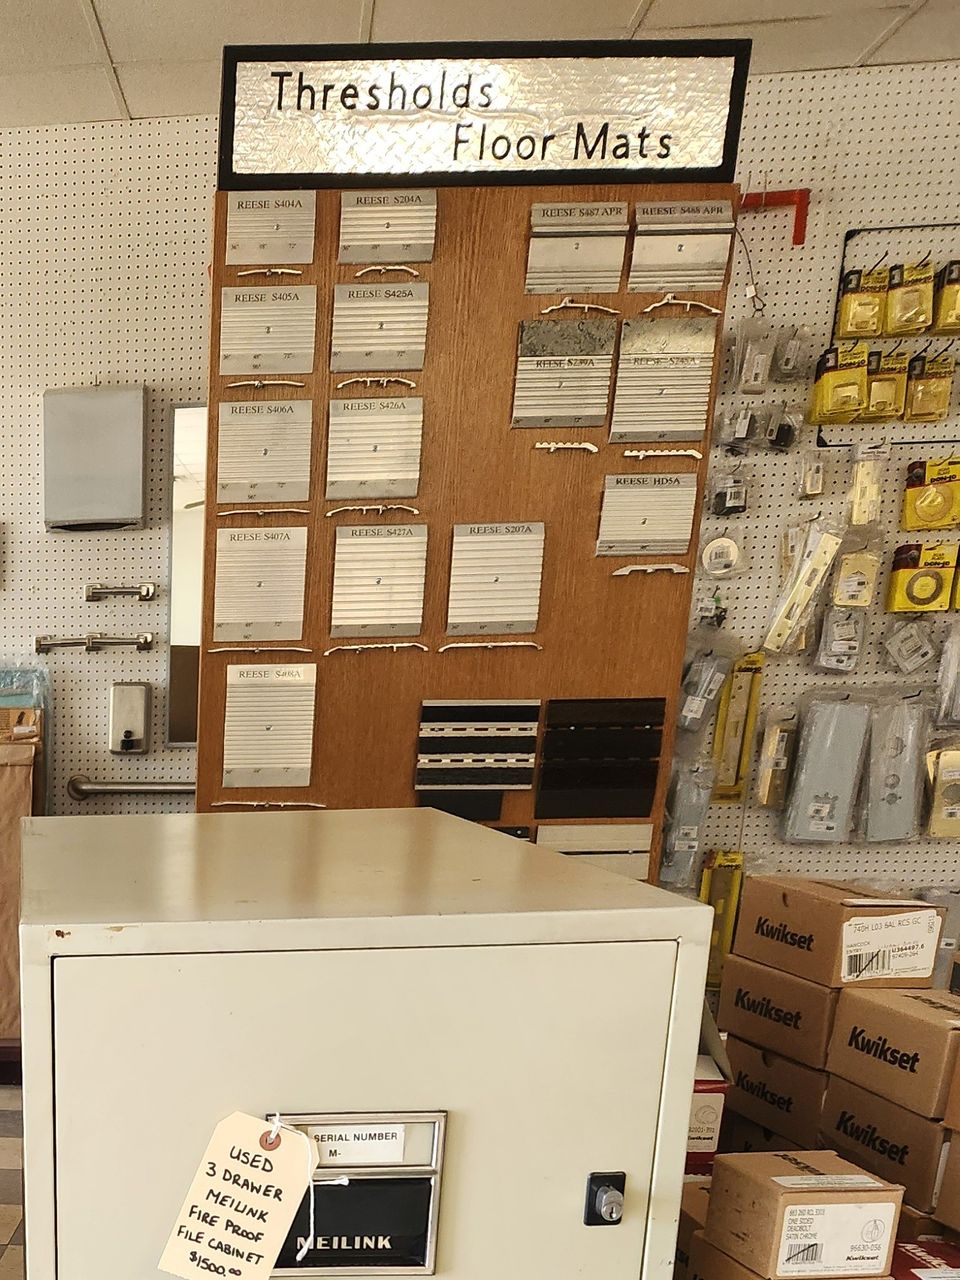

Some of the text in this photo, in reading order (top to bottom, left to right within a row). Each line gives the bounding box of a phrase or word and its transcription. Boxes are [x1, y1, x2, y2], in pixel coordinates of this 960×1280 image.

[270, 69, 494, 111] Thresholds
[453, 121, 673, 161] Floor Mats
[237, 200, 303, 210] REESE S404A
[356, 195, 422, 205] REESE S204A
[542, 207, 577, 218] REESE
[642, 206, 676, 216] REESE
[234, 293, 300, 303] REESE S405A
[348, 289, 414, 299] REESE S425A
[231, 405, 295, 415] REESE S406A
[343, 401, 406, 411] REESE S426A
[616, 477, 681, 485] REESE HD5A
[351, 528, 414, 537] REESE S427A
[469, 525, 532, 534] REESE S207A
[230, 532, 290, 542] REESE S407A
[238, 670, 269, 679] REESE
[754, 916, 815, 951] Kwikset
[734, 988, 802, 1030] Kwikset
[847, 1026, 920, 1073] Kwikset
[735, 1070, 794, 1113] Kwikset
[314, 1132, 398, 1143] SERIAL NUMBER
[834, 1110, 909, 1166] Kwikset
[229, 1145, 274, 1173] USED
[205, 1161, 283, 1202] 3 DRAWER
[205, 1188, 269, 1224] MEILINK
[188, 1204, 265, 1243] FIRE PROOF
[176, 1225, 265, 1266] FILE CABINET
[296, 1236, 393, 1250] MEILINK
